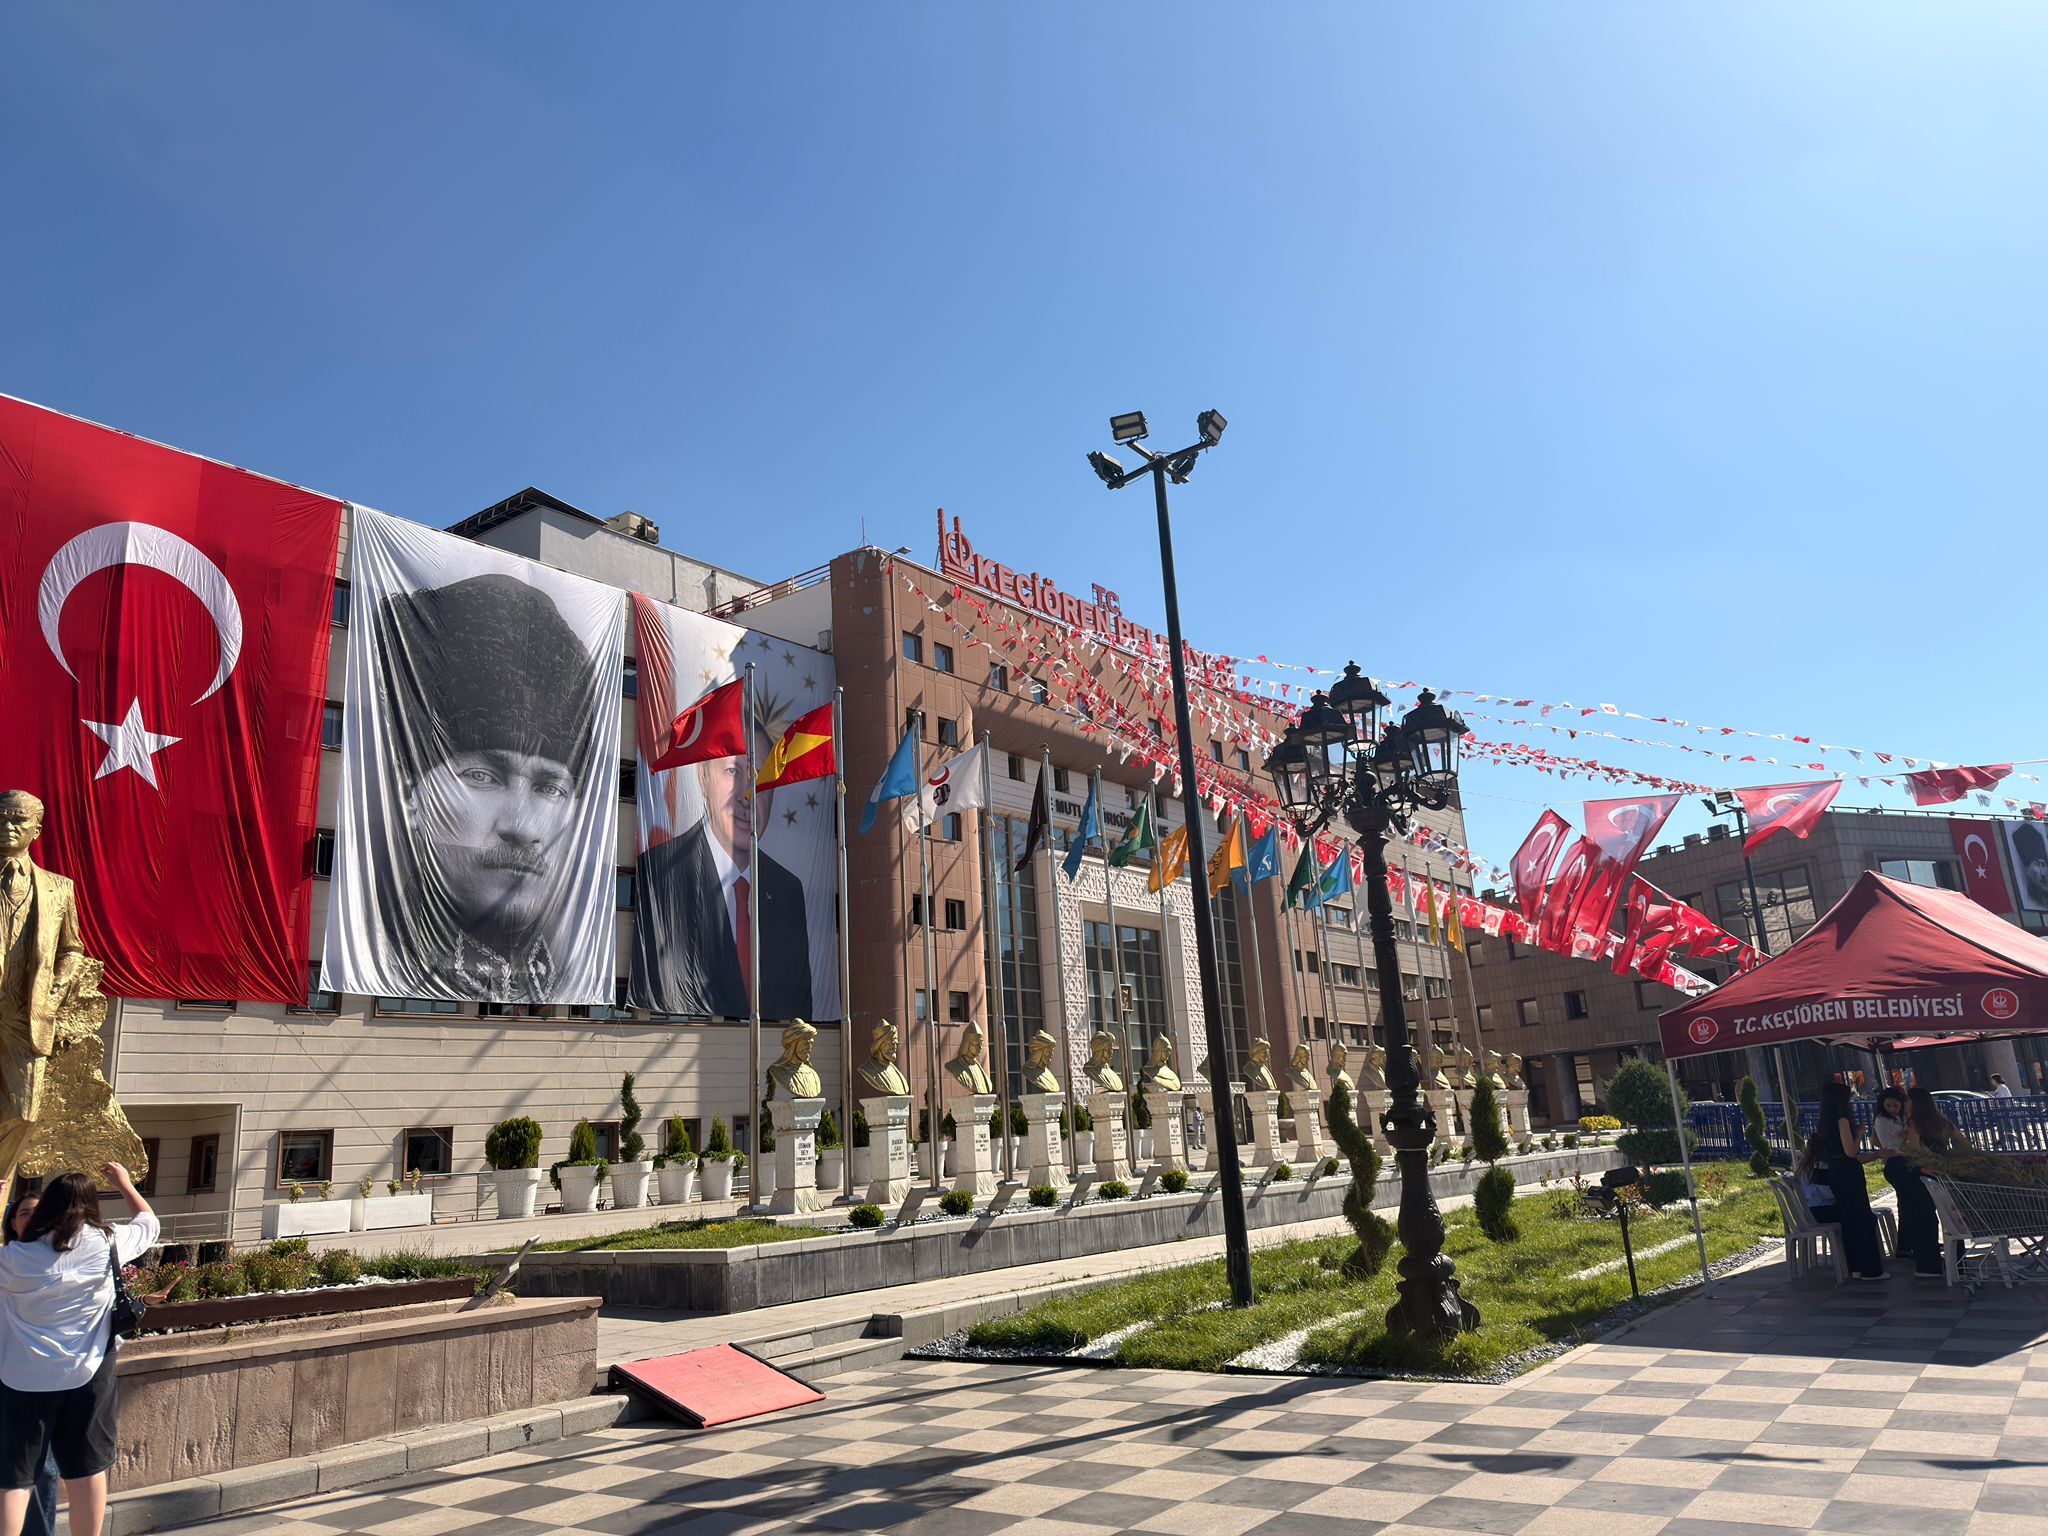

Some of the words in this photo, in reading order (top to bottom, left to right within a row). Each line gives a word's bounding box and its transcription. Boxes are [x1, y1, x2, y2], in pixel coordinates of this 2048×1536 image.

[973, 553, 1111, 638] KEÇİÖREN
[1055, 799, 1081, 817] MUTL
[1852, 993, 1964, 1018] BELEDİYESİ
